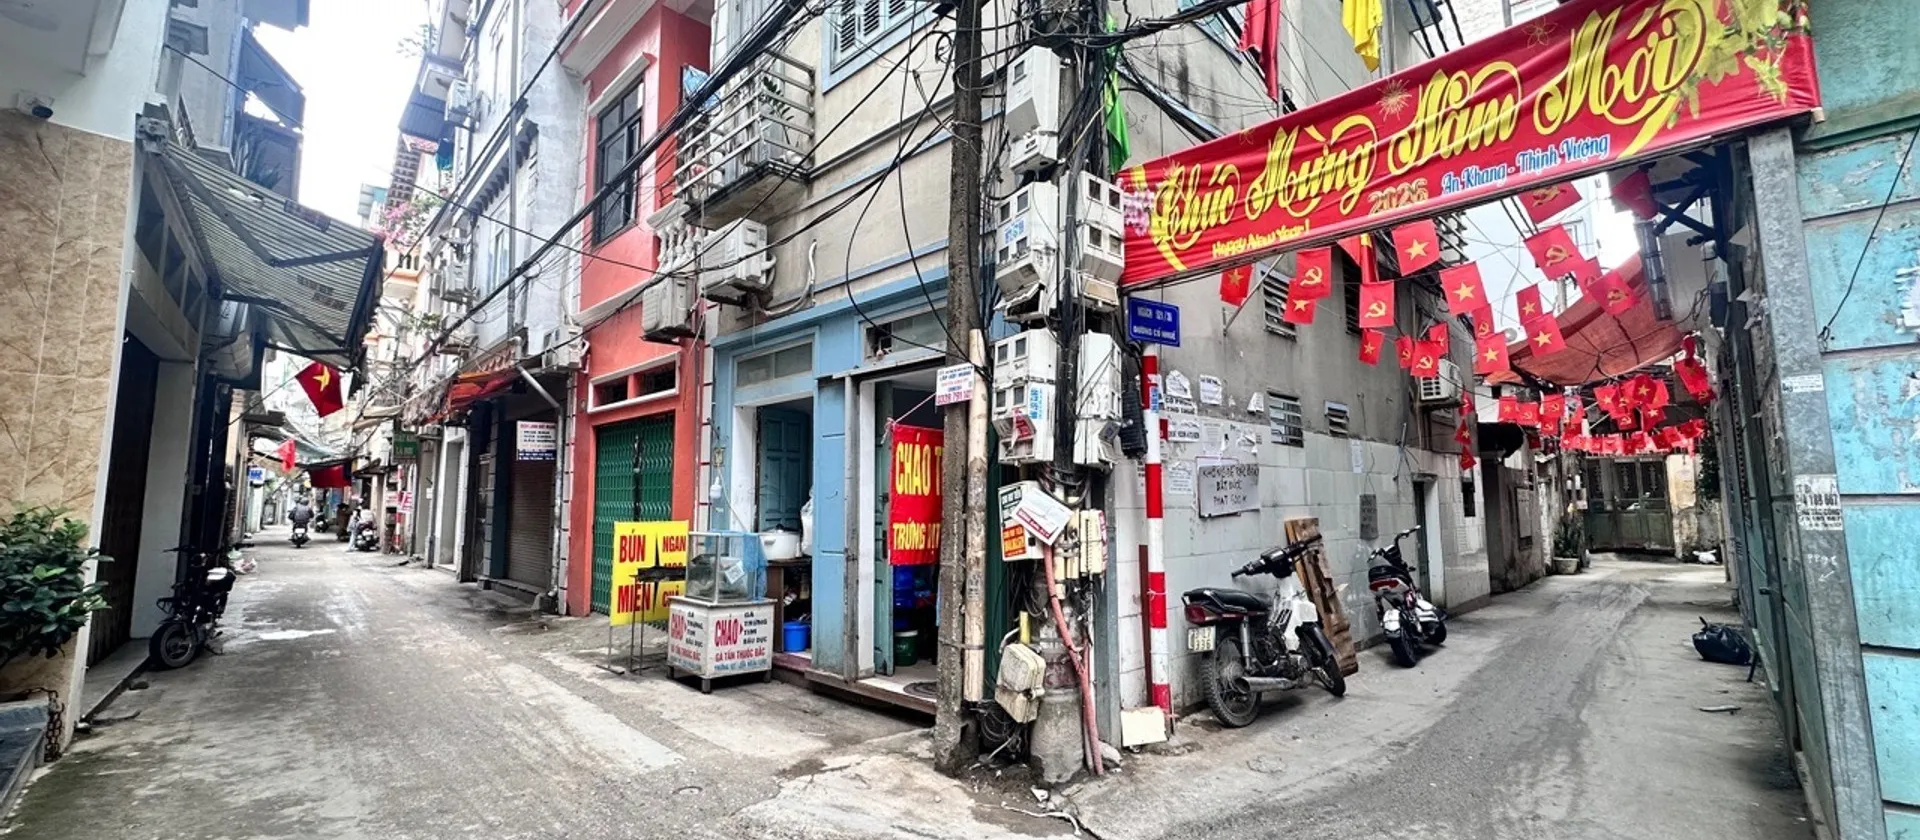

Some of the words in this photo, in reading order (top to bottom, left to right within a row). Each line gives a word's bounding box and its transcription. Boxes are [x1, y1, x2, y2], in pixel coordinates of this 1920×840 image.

[1152, 162, 1241, 250] Chúc
[1245, 114, 1378, 218] Mừng
[1387, 60, 1522, 176] Năm
[1532, 0, 1706, 136] Mới
[1443, 172, 1461, 195] An
[1462, 163, 1507, 189] Khang
[1517, 149, 1560, 174] Thịnh
[1561, 134, 1610, 164] Vượng
[1368, 178, 1429, 216] 2026
[1212, 237, 1246, 258] Happy
[1247, 232, 1276, 250] New
[896, 432, 931, 496] CHÁO
[619, 528, 646, 563] BÚN
[662, 535, 687, 553] NGAN
[893, 516, 926, 550] TRỨNG
[714, 613, 739, 647] CHÁO
[744, 618, 768, 627] TRỨNG
[736, 647, 754, 660] THUỐC
[754, 645, 766, 658] BẮC
